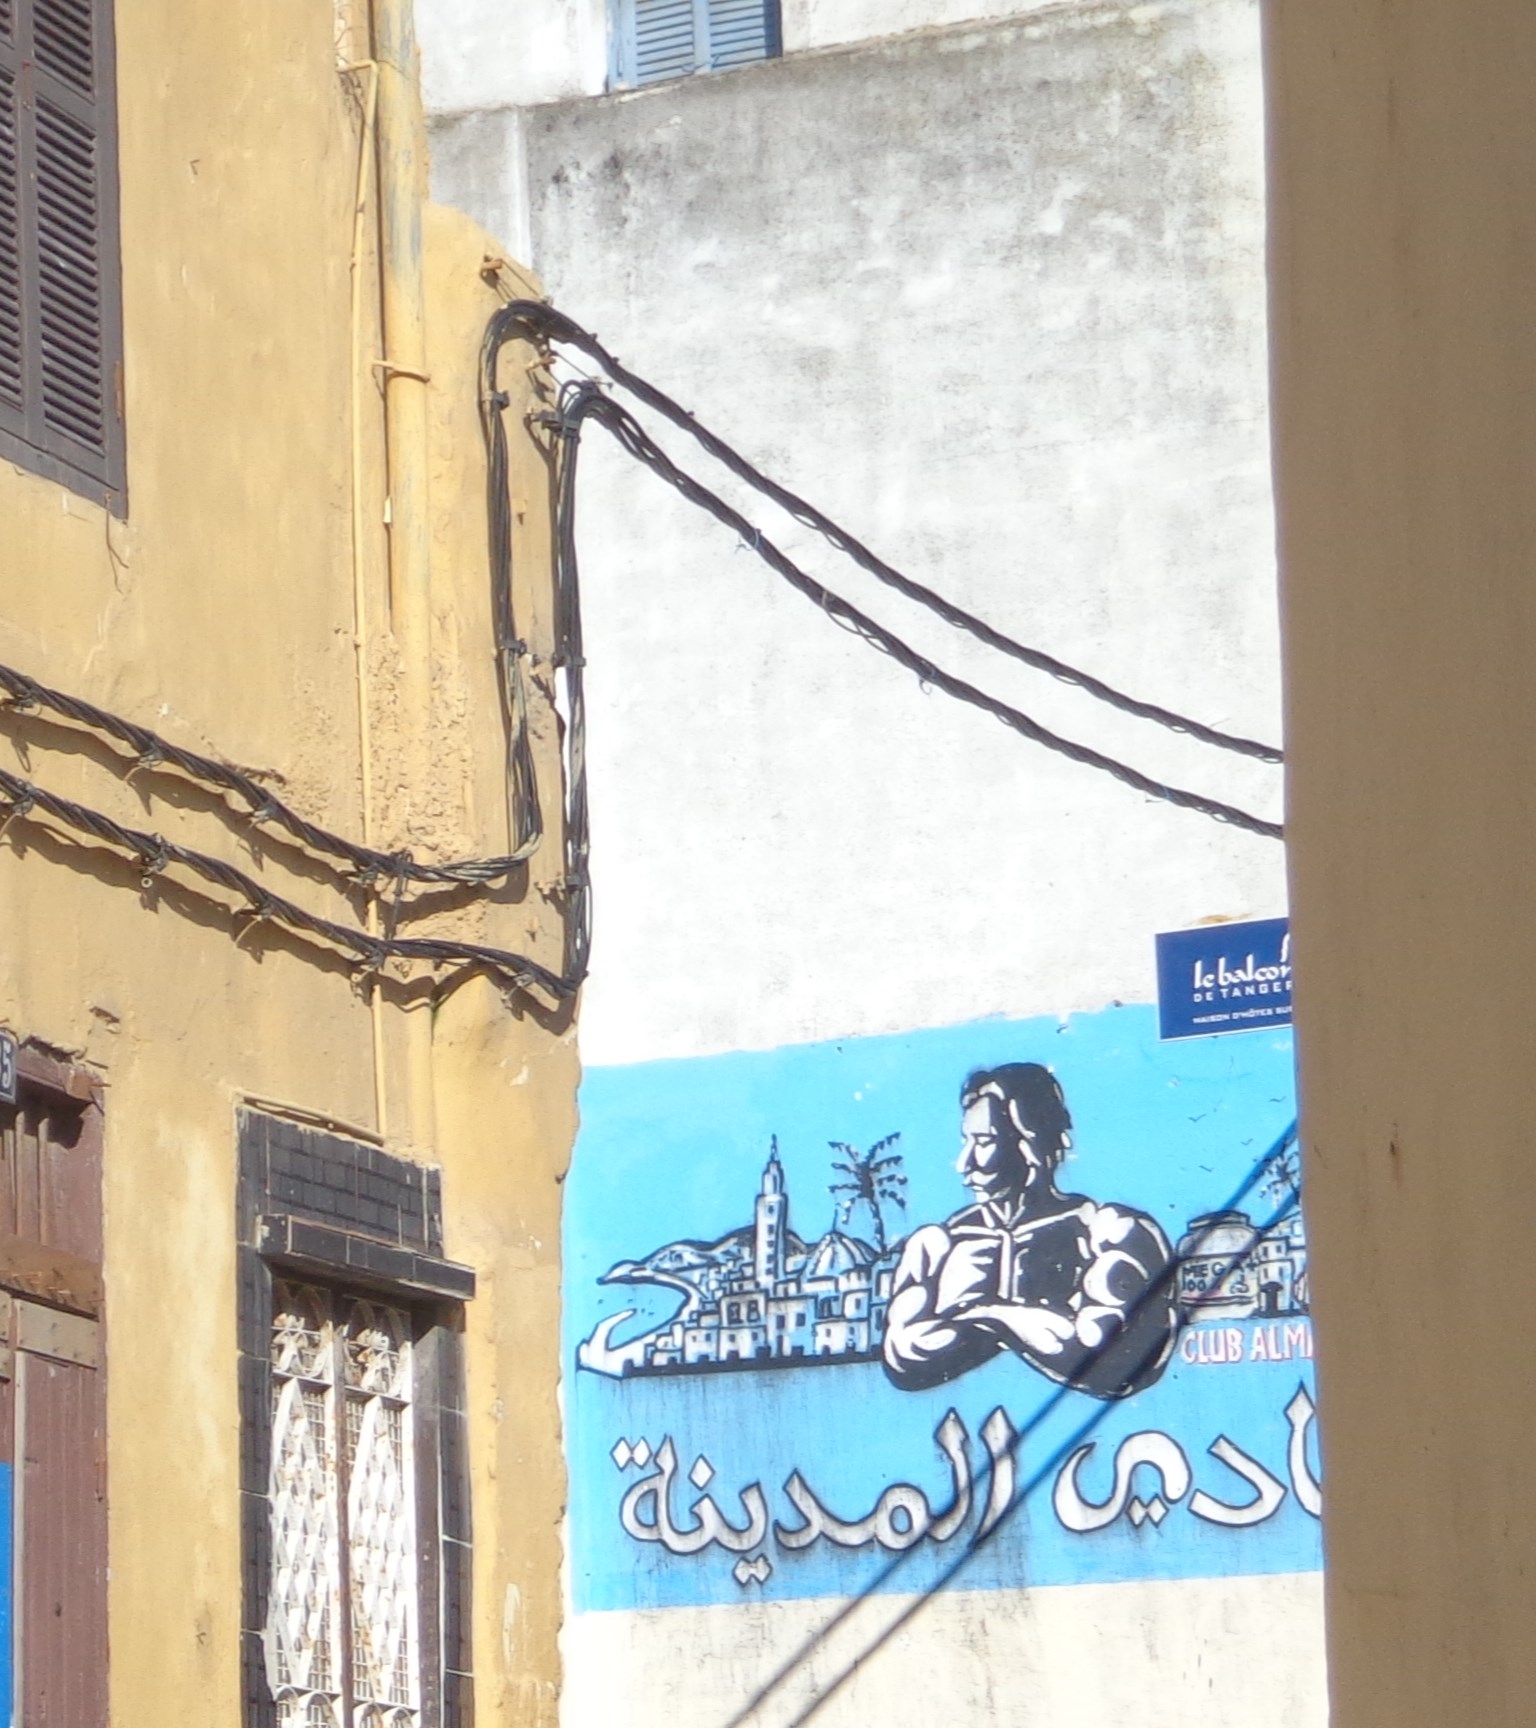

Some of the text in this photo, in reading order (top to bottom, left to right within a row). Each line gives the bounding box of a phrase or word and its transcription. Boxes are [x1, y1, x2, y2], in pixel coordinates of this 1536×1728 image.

[1193, 959, 1215, 989] le
[1193, 991, 1214, 1003] DE
[1180, 1327, 1244, 1364] CLUB
[610, 1380, 1324, 1588] ادي المدينة
